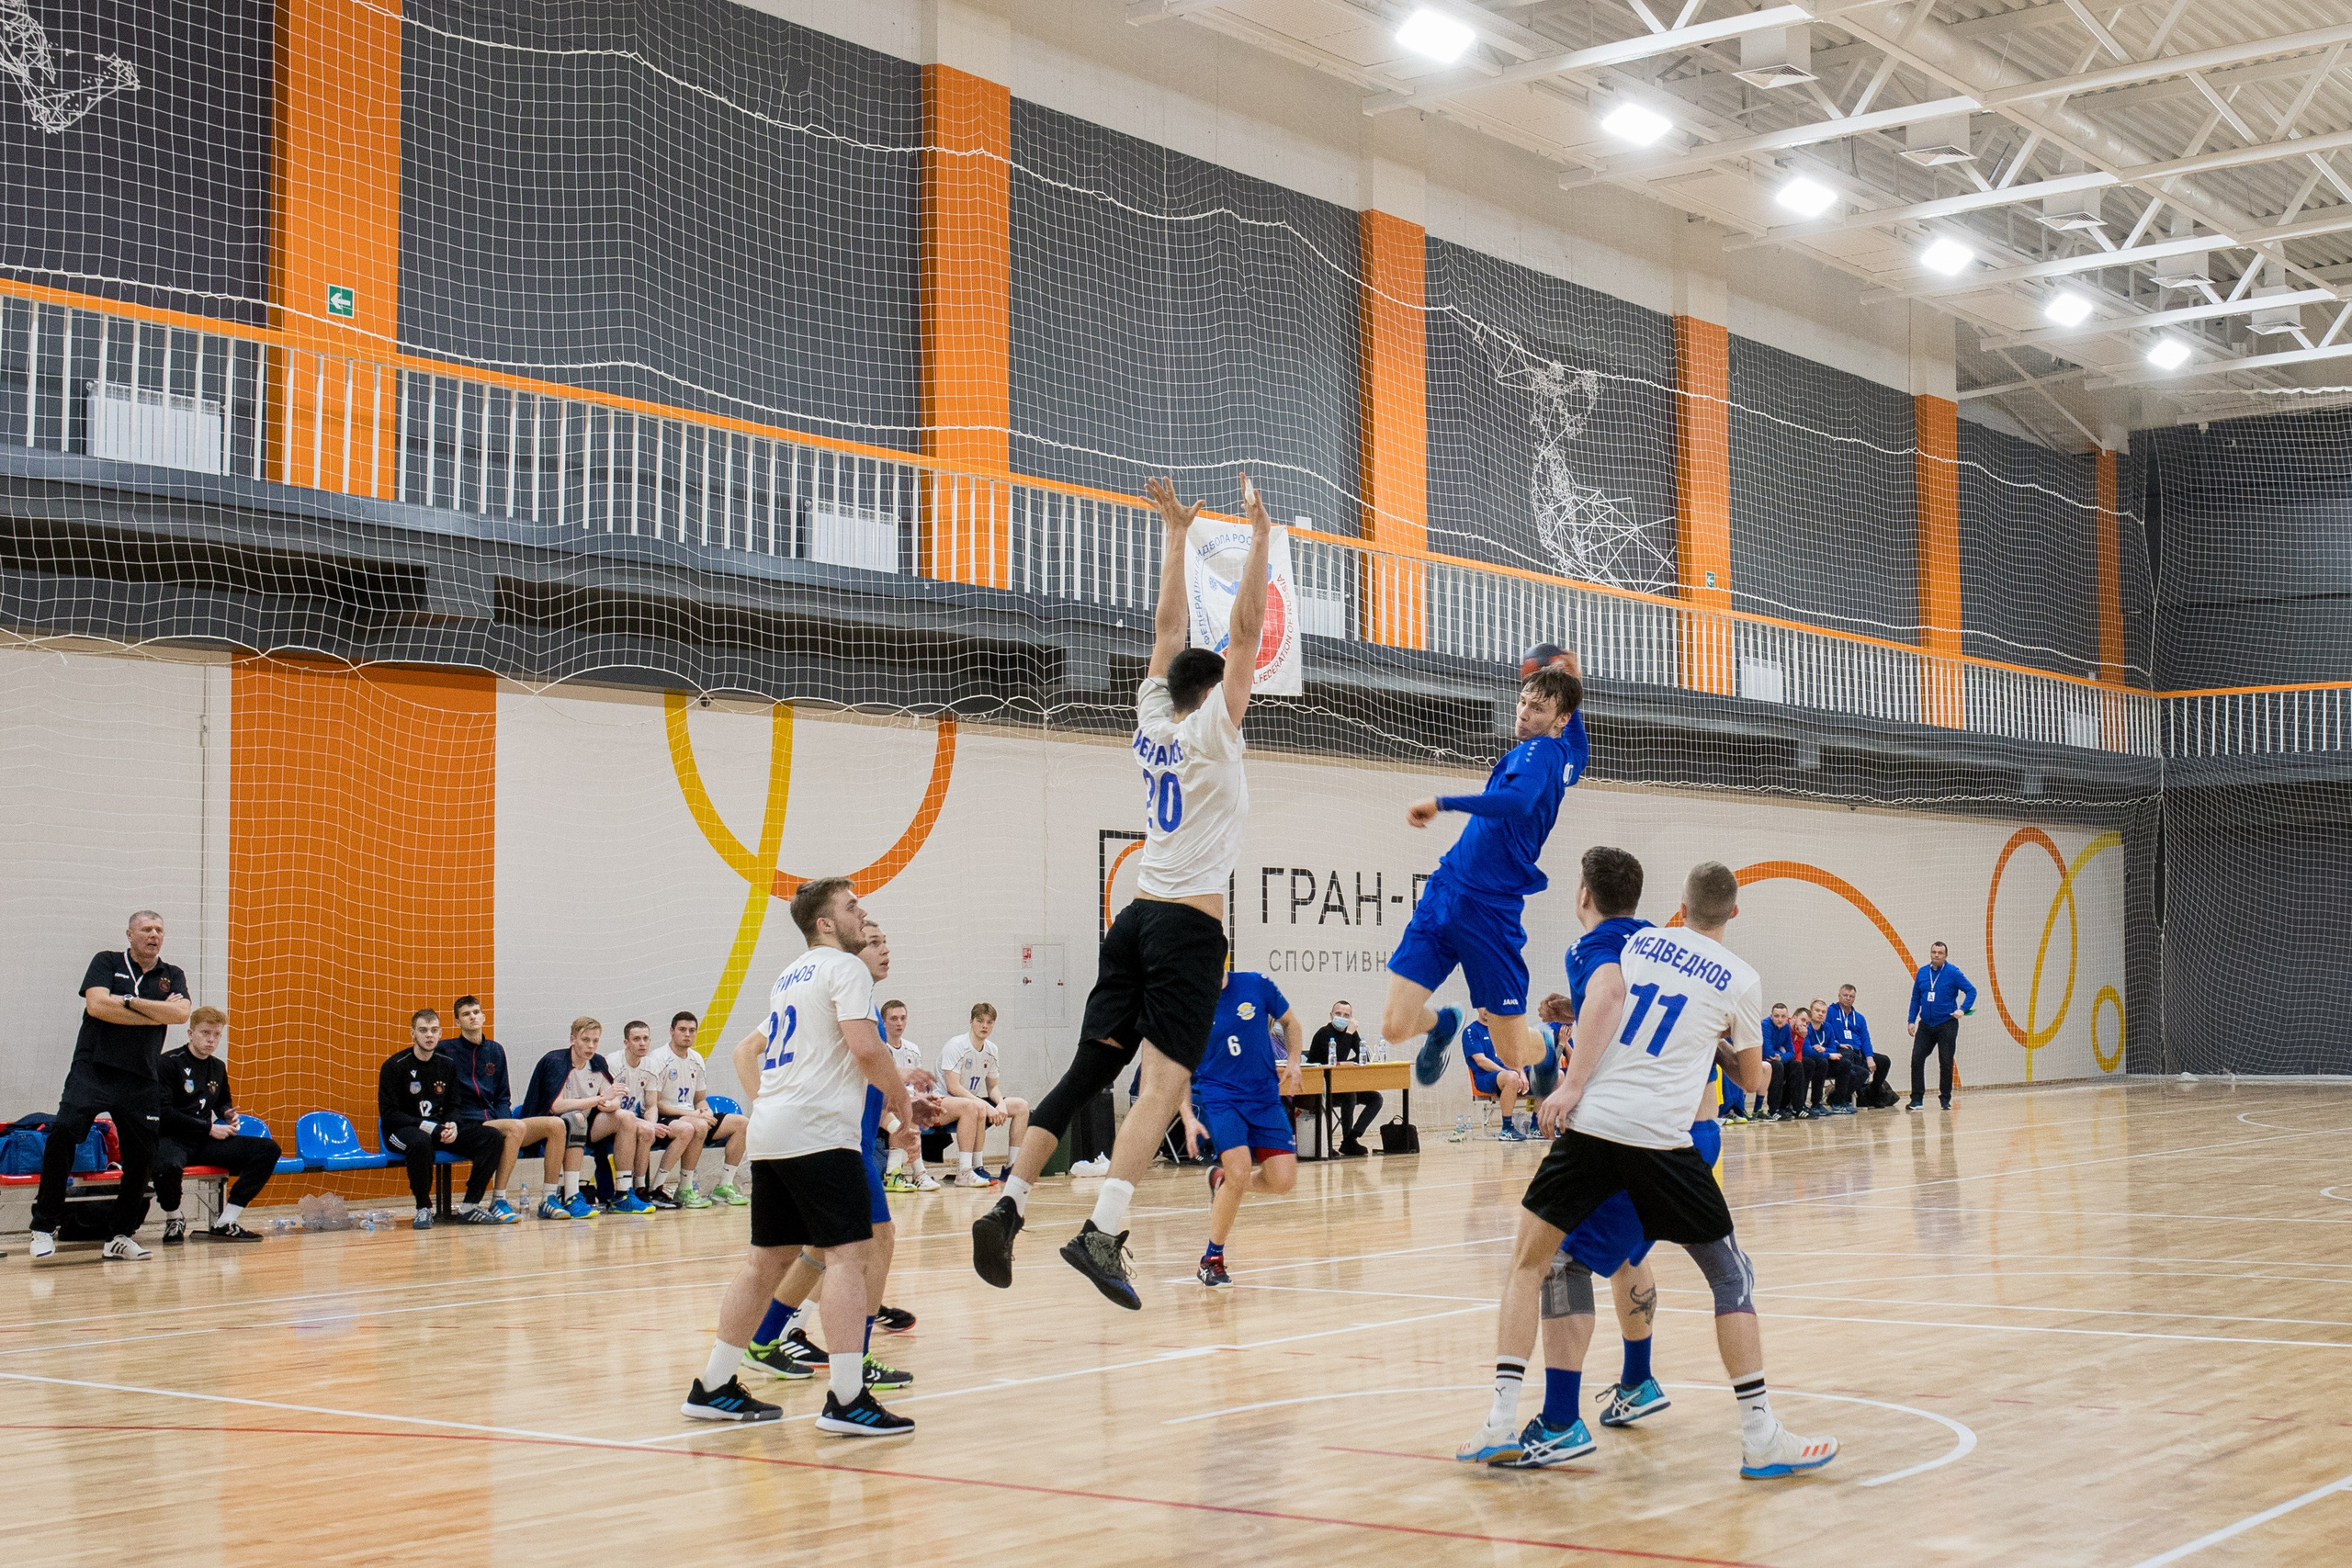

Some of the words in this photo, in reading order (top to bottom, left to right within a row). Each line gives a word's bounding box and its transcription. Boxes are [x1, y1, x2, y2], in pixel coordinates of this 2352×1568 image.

[1232, 533, 1252, 546] РОС
[1258, 635, 1293, 683] FEDERATION
[1287, 619, 1294, 634] OF
[1269, 949, 1394, 972] СПОРТИВН
[1628, 935, 1733, 992] МЕДВЕДКОВ
[1619, 982, 1689, 1057] 11
[763, 1004, 797, 1071] 22
[1227, 1034, 1241, 1056] 6
[969, 1076, 980, 1090] 17
[620, 1096, 636, 1110] 38
[678, 1088, 689, 1102] 27
[419, 1100, 433, 1117] 12
